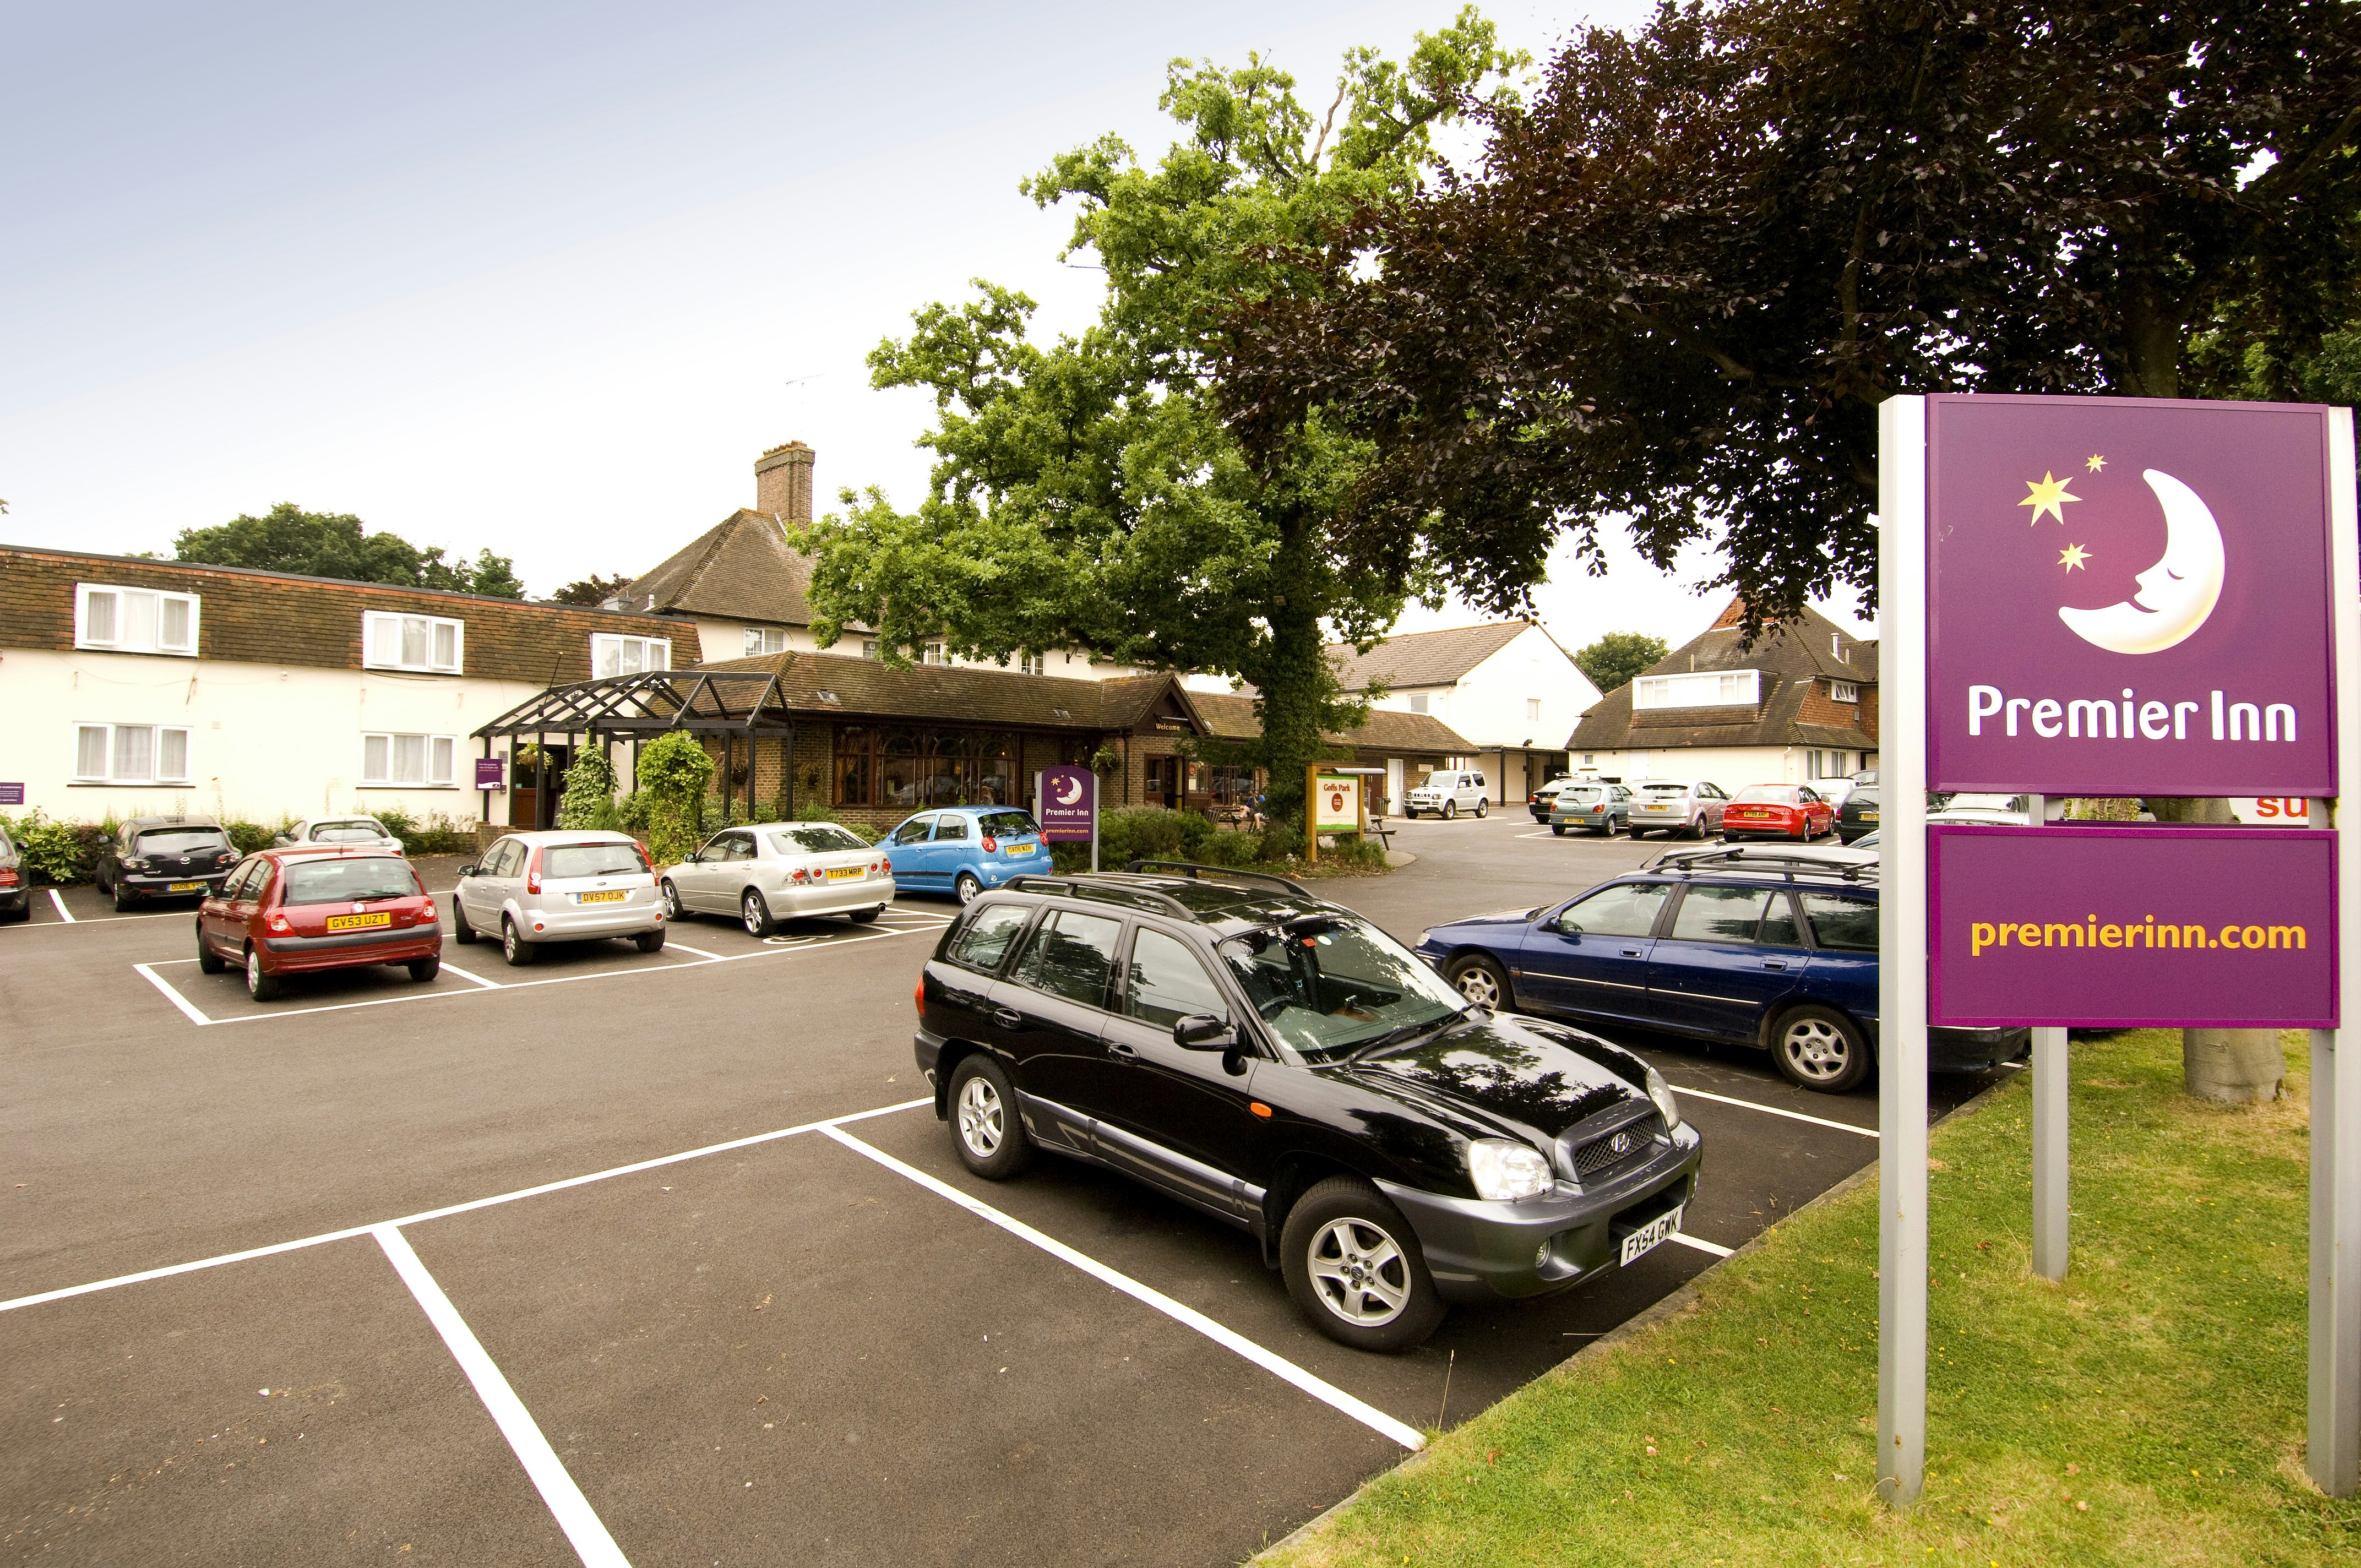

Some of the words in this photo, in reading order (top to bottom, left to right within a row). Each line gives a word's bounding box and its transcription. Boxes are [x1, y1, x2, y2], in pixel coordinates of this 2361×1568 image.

[1968, 685, 2199, 740] Premier
[2211, 690, 2297, 742] Inn
[1155, 723, 1180, 731] Welcome
[829, 869, 847, 878] T733
[584, 892, 606, 901] DV57
[608, 891, 624, 900] OJK
[333, 917, 361, 928] GV53
[365, 914, 385, 924] UZT
[1971, 914, 2307, 956] premierinn.com
[1626, 1225, 1655, 1260] FX54
